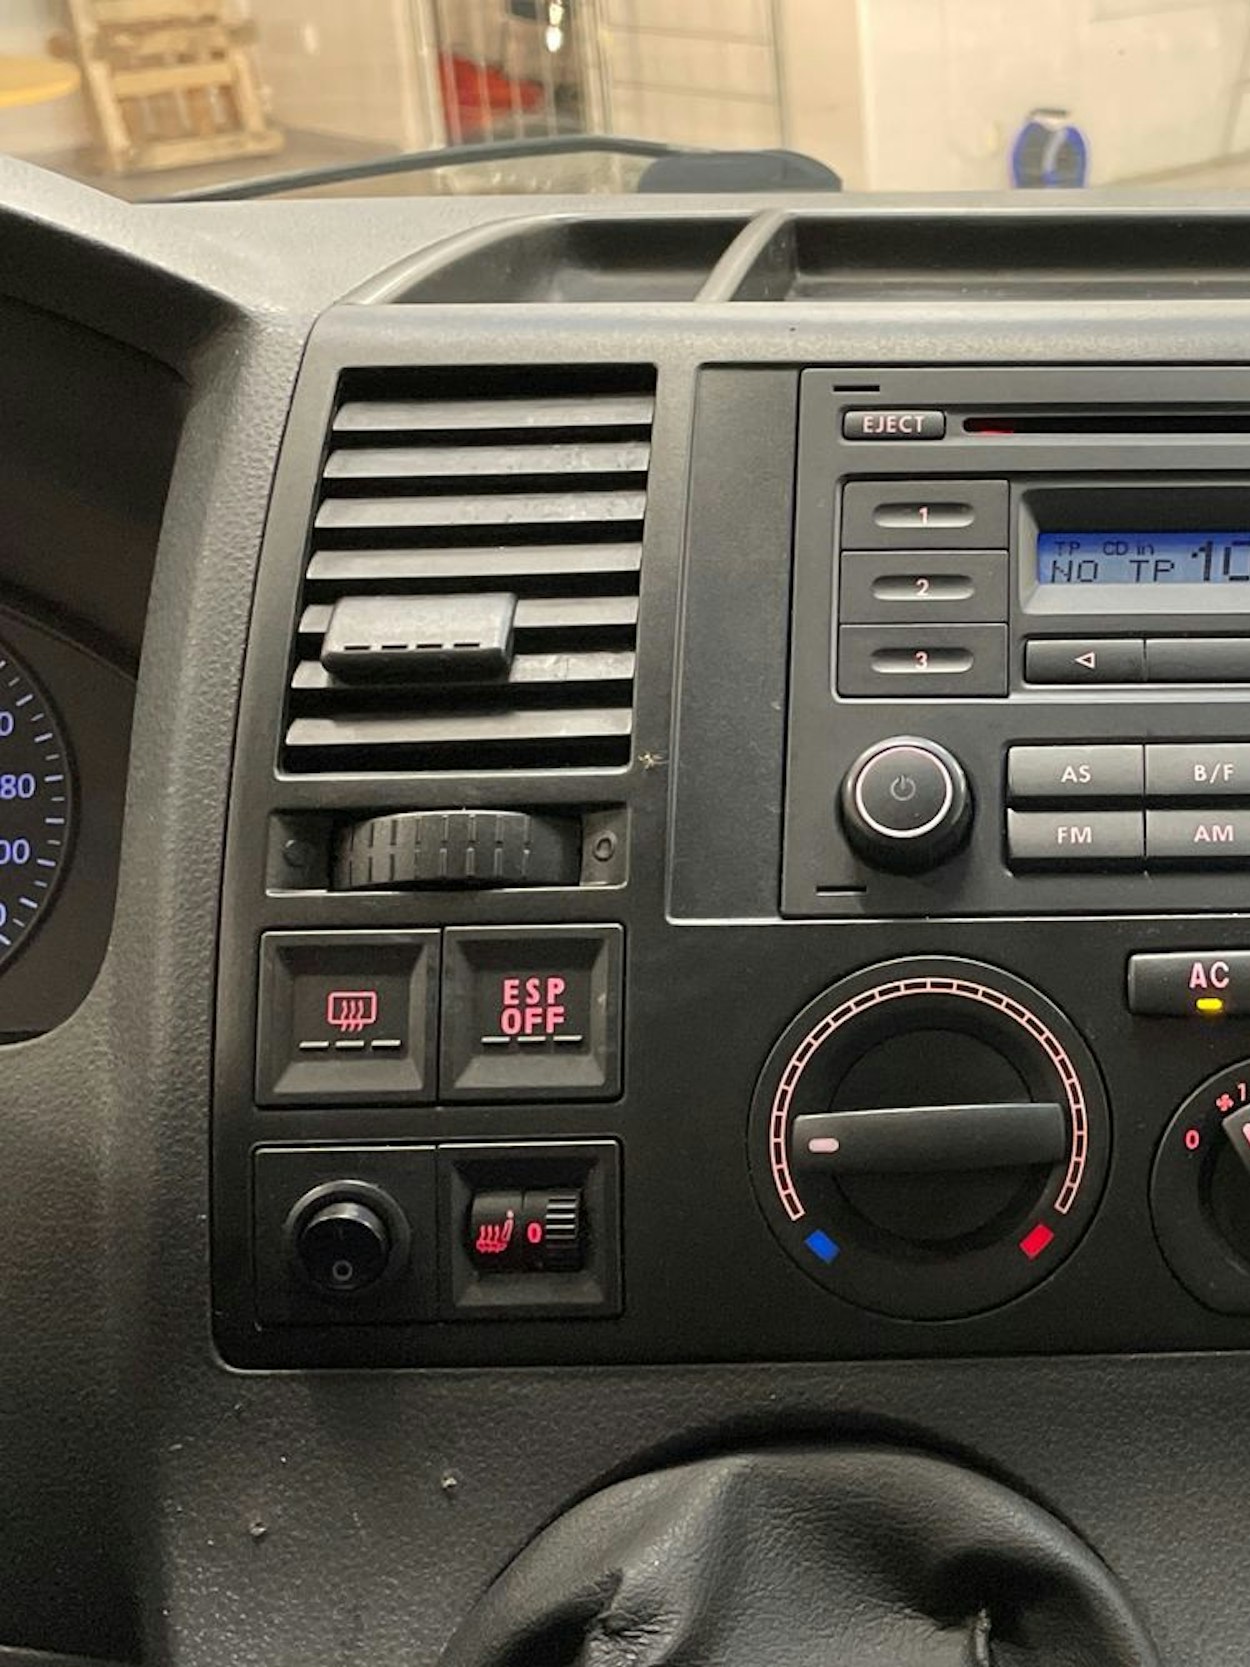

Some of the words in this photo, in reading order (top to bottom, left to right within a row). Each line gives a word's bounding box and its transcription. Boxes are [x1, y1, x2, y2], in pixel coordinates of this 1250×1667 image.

[863, 415, 926, 433] EJECT
[918, 507, 929, 525] 1
[1054, 541, 1081, 557] TP
[1102, 541, 1129, 557] CD
[1136, 541, 1155, 557] in
[1051, 560, 1099, 583] NO
[1129, 560, 1175, 583] TP
[915, 579, 929, 597] 2
[914, 651, 929, 670] 3
[1060, 764, 1092, 784] AS
[1193, 762, 1235, 784] B/F
[1056, 826, 1093, 845] FM
[1193, 823, 1235, 843] AM
[1188, 961, 1230, 989] AC
[502, 977, 566, 1005] ESP
[500, 1007, 566, 1035] OFF
[1237, 1082, 1247, 1101] 1
[1185, 1129, 1201, 1150] 0
[527, 1222, 543, 1243] 0
